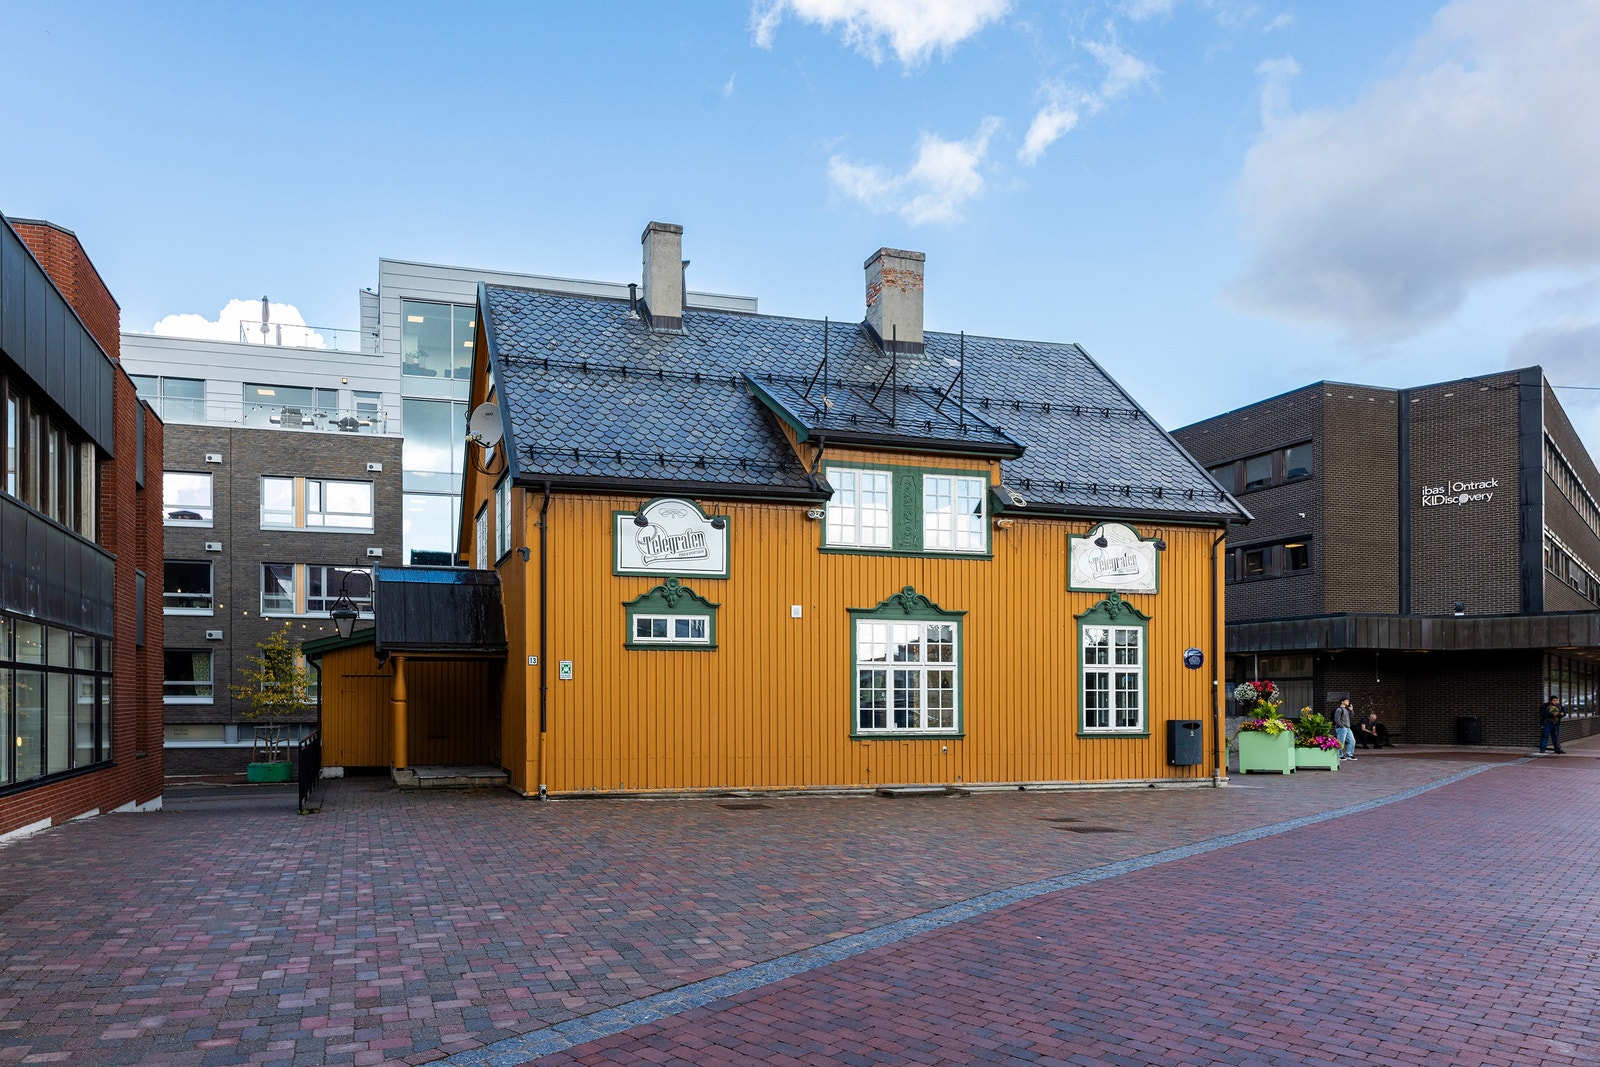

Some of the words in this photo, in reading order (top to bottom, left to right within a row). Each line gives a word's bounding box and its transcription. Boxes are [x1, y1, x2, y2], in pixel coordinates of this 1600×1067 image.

[1422, 486, 1445, 495] ibas
[1452, 477, 1499, 491] Ontrack
[643, 531, 705, 554] Telegrafen
